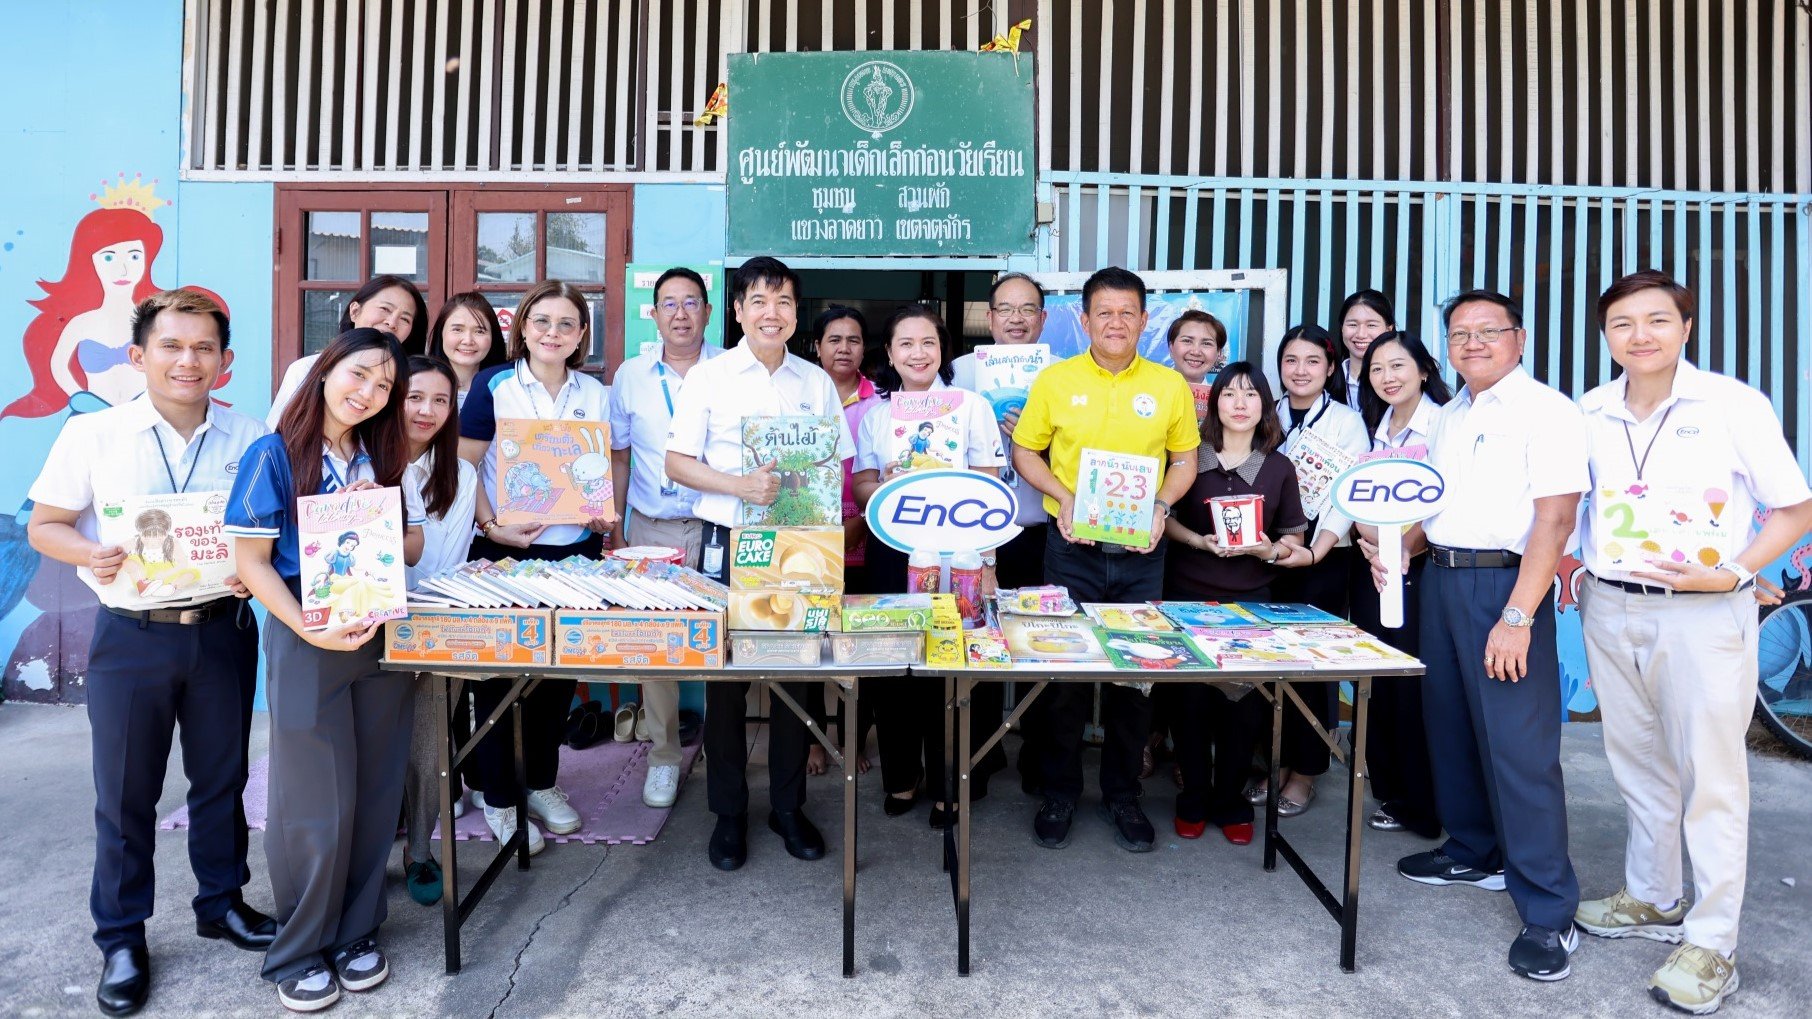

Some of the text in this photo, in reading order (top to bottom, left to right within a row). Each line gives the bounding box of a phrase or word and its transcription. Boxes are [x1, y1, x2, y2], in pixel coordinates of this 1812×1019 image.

[739, 140, 1025, 185] ศูนย์พัฒนาเด็กเล็กก่อนวัยเรียน
[812, 182, 950, 213] ชุมชน สวนผัก
[791, 213, 971, 247] แขวงลาดยาว เขตจตุจักร
[765, 423, 819, 446] ต้นไม้
[1106, 471, 1126, 498] 2
[1129, 474, 1147, 500] 3
[1348, 479, 1444, 503] EnCo
[891, 495, 1012, 531] EnCo
[1603, 502, 1649, 539] 2
[174, 520, 226, 539] รองเท้
[190, 536, 218, 547] ของ
[738, 538, 773, 552] EURO
[190, 543, 229, 561] มะลิ
[736, 550, 771, 564] CAKE
[304, 611, 323, 622] 3D
[521, 625, 538, 642] 4
[692, 628, 710, 645] 4
[452, 650, 479, 661] รสจืด
[623, 653, 650, 665] รสจืด
